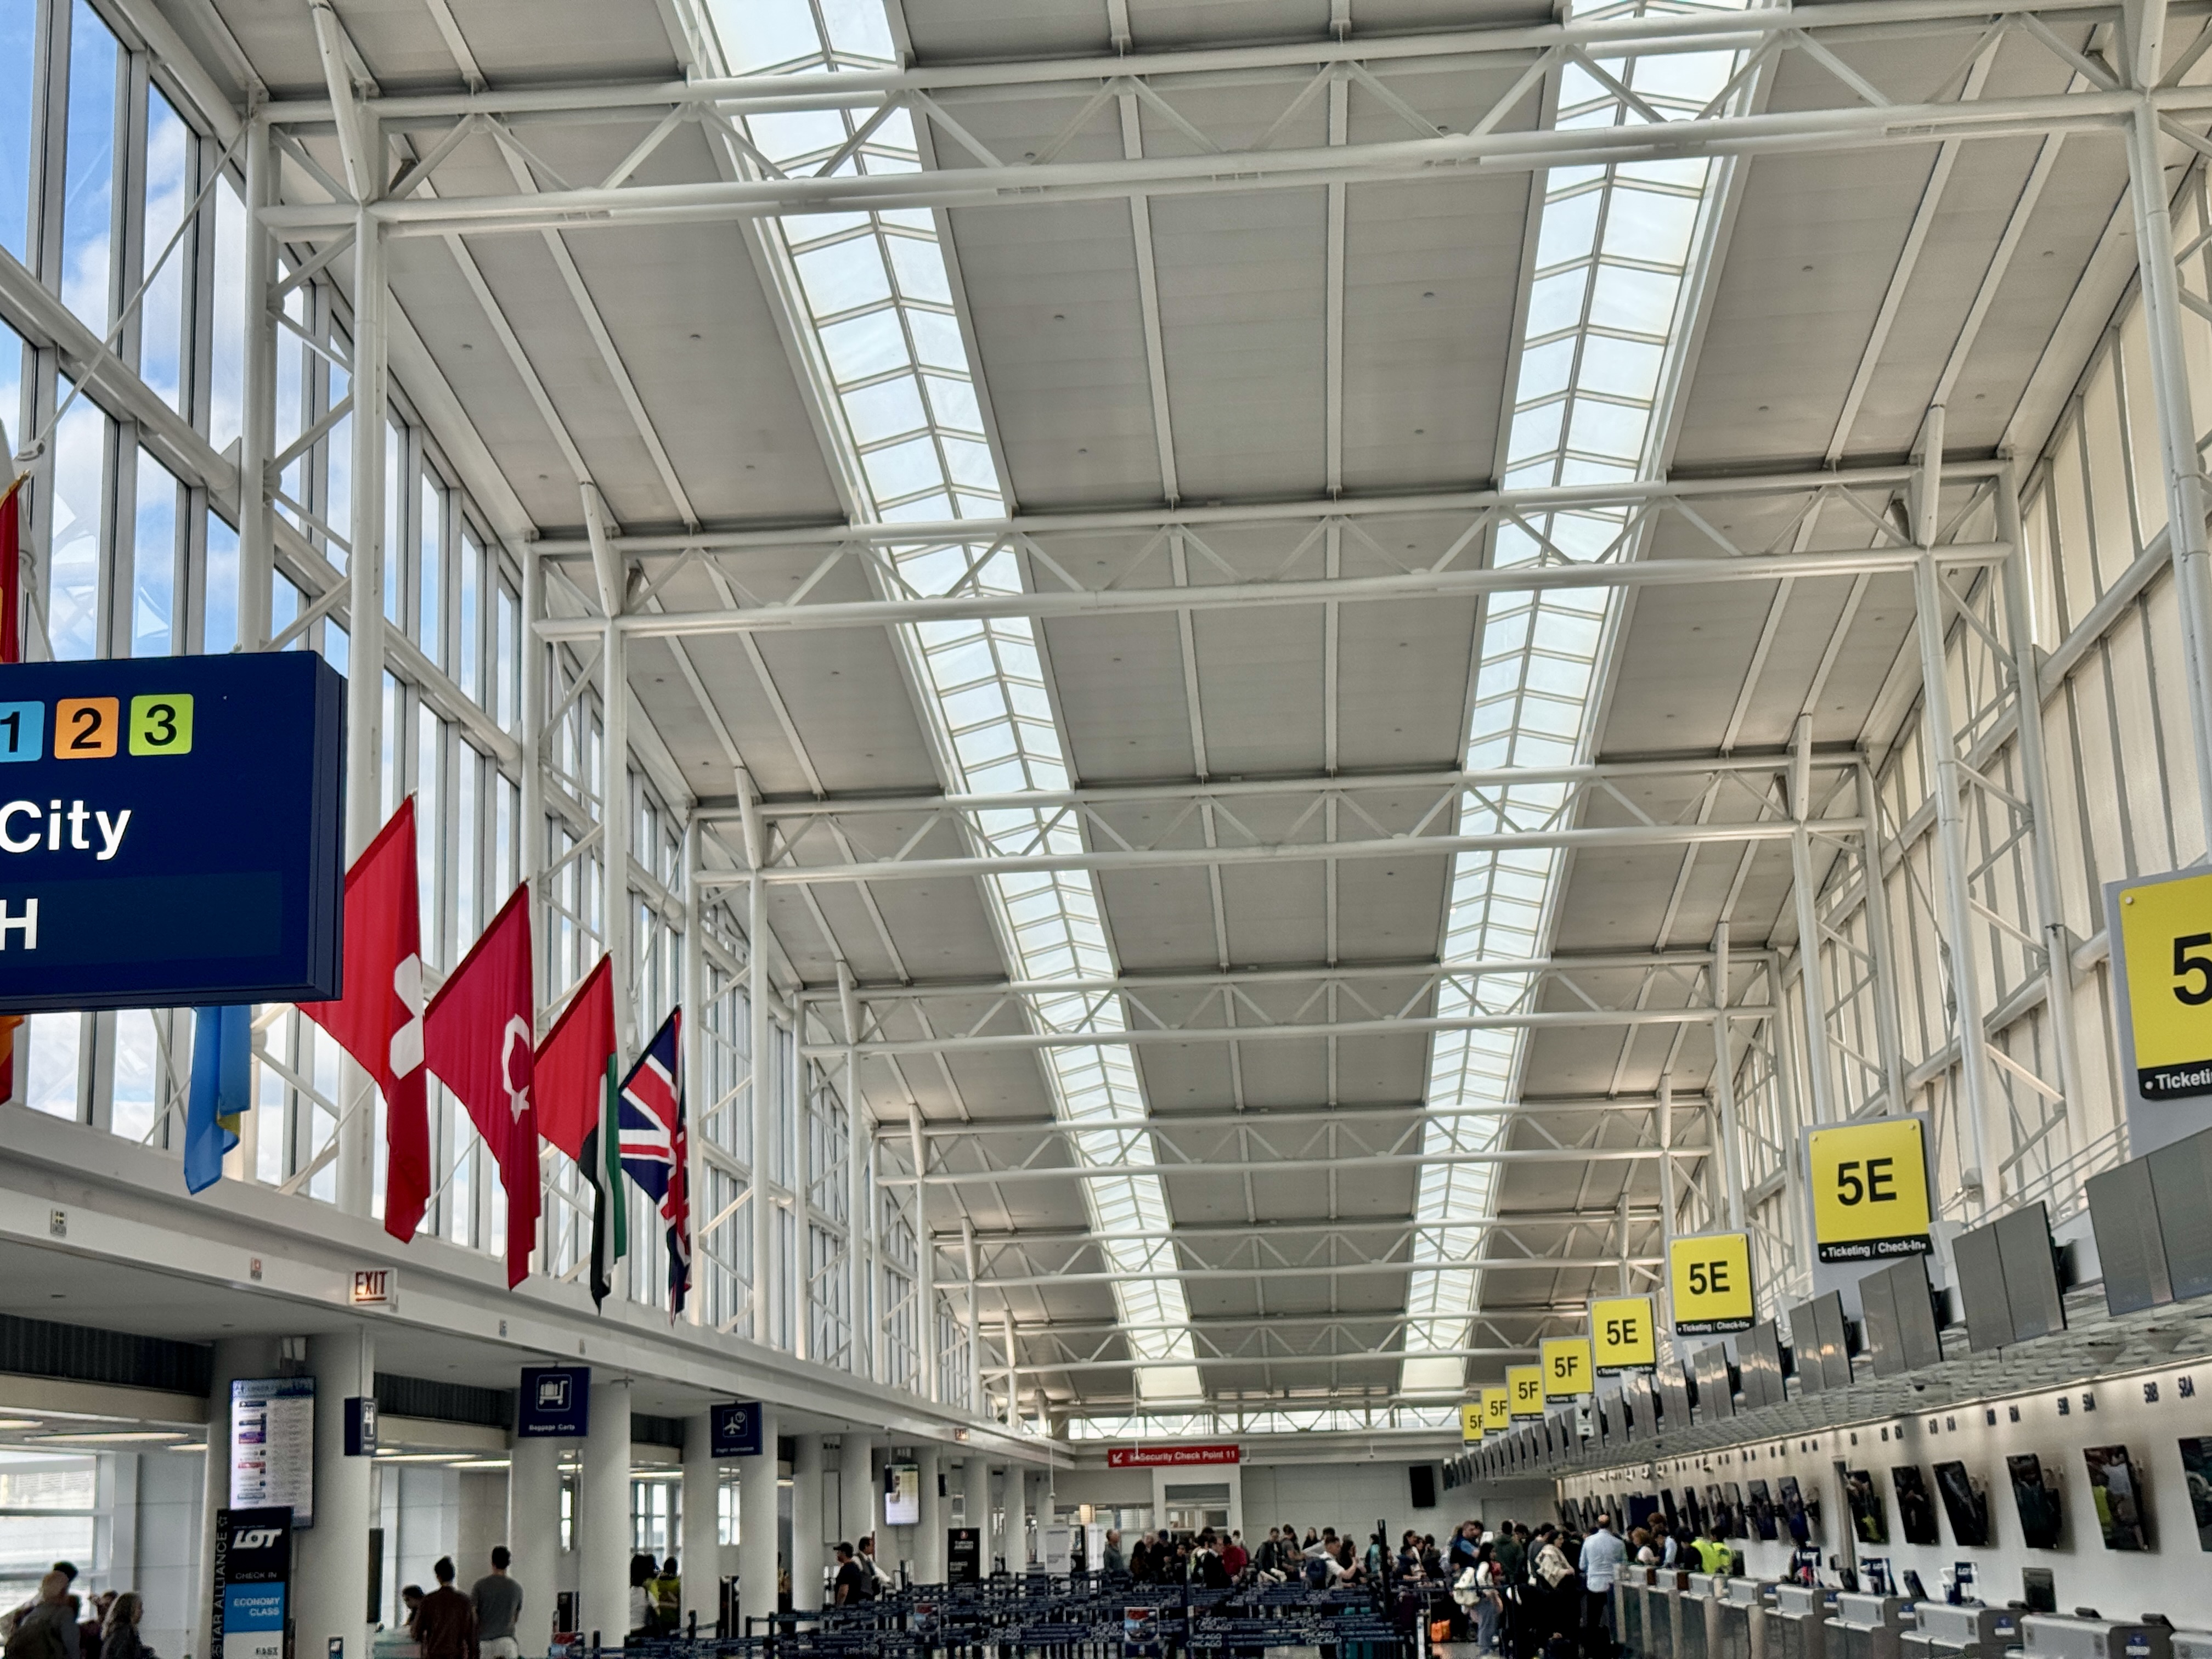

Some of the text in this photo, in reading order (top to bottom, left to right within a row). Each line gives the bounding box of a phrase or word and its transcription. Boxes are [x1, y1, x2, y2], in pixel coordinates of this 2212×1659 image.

[0, 704, 177, 753] 1 2 3
[0, 799, 132, 860] City
[2172, 933, 2212, 1006] 5
[2154, 1068, 2212, 1091] Ticketi
[1837, 1157, 1897, 1206] 5E
[1827, 1244, 1871, 1258] Ticketing
[1878, 1239, 1921, 1254] Check-In
[355, 1270, 387, 1295] EXIT
[1689, 1261, 1731, 1295] 5E
[1606, 1318, 1639, 1345] 5E
[1682, 1322, 1712, 1333] Ticketing
[1554, 1356, 1579, 1378] 5F
[1518, 1381, 1539, 1400] 5F
[1490, 1400, 1508, 1417] 5F
[1139, 1453, 1173, 1462] Security
[1175, 1452, 1200, 1460] Check
[232, 1528, 283, 1550] LOT
[214, 1531, 228, 1609] ALLIANCE
[233, 1597, 280, 1607] ECONOMY
[249, 1607, 280, 1616] CLASS
